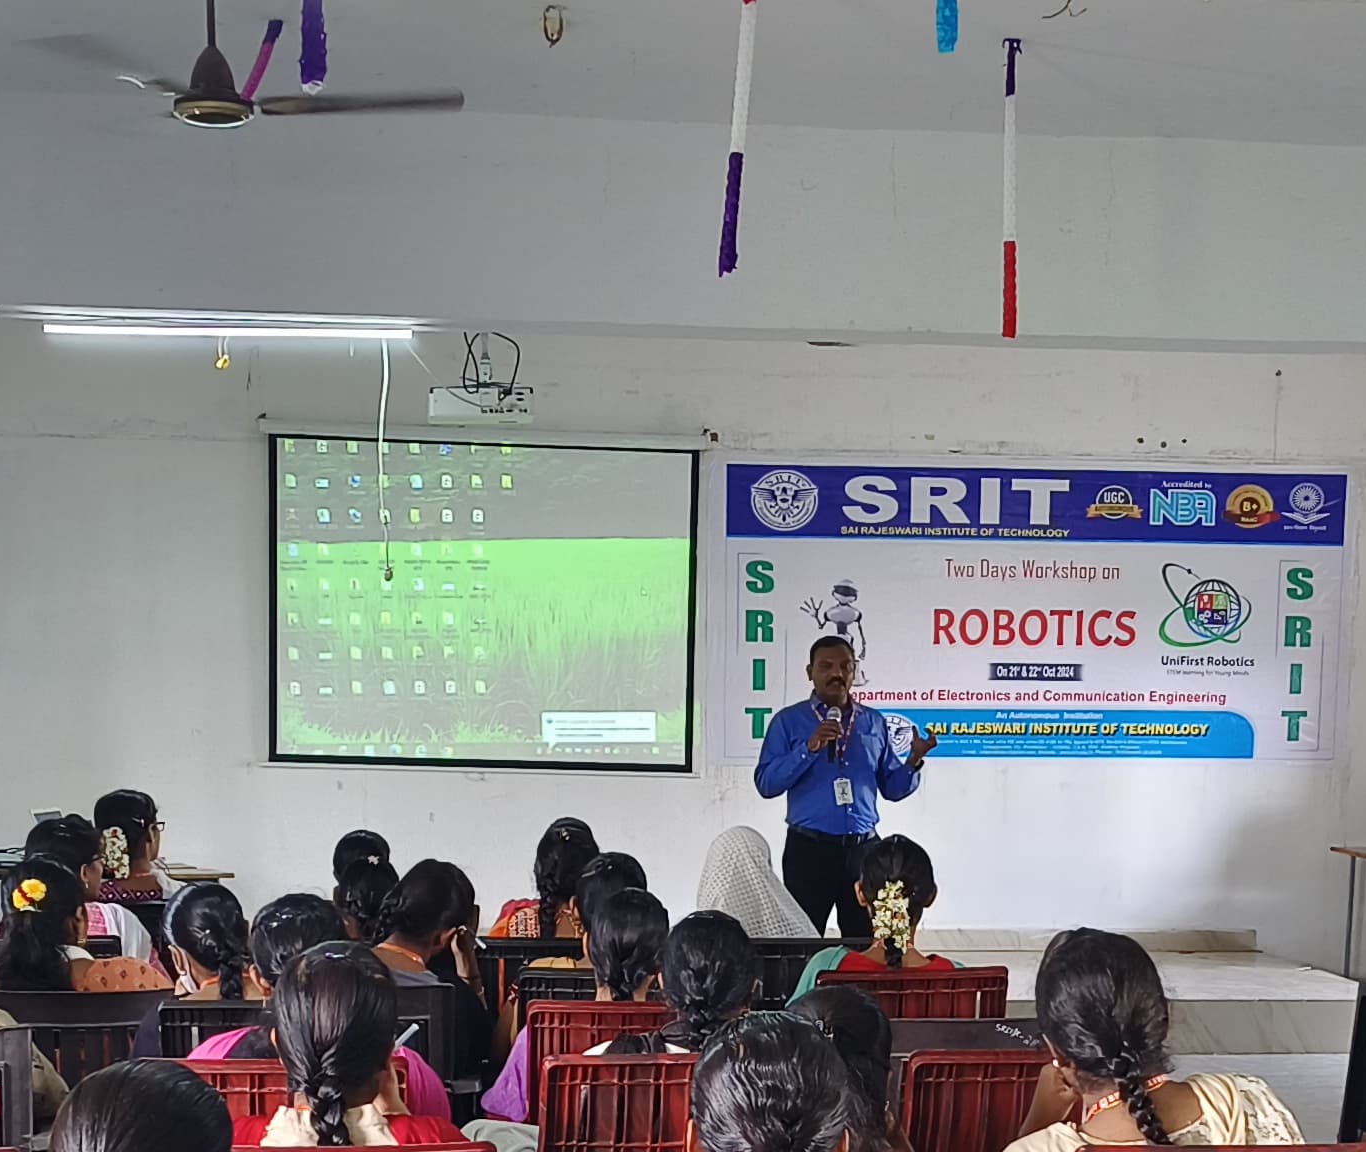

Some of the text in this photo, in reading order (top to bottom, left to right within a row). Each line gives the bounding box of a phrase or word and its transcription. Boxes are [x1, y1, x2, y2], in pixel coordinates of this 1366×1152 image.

[1161, 480, 1203, 488] Accredited
[841, 475, 1070, 525] SRIT
[1103, 491, 1125, 503] UGC
[1149, 488, 1217, 526] NBA
[1242, 501, 1258, 512] B+
[841, 526, 1070, 538] SAI RAJESWARI INSTITUTE OF TECHNOLOGY
[944, 558, 1121, 583] Two Days Workshop on
[932, 607, 1137, 648] ROBOTICS
[744, 560, 775, 739] SRIT
[1280, 567, 1314, 742] SRIT
[1161, 655, 1255, 667] UniFirst Robotics
[996, 665, 1008, 677] On
[1043, 666, 1055, 677] Oct
[1057, 666, 1074, 677] 2024
[850, 688, 1227, 706] epartment of Electronics and Communication Engineering
[925, 721, 1210, 737] SAI RAJESWARI INSTITUTE OF TECHNOLOGY
